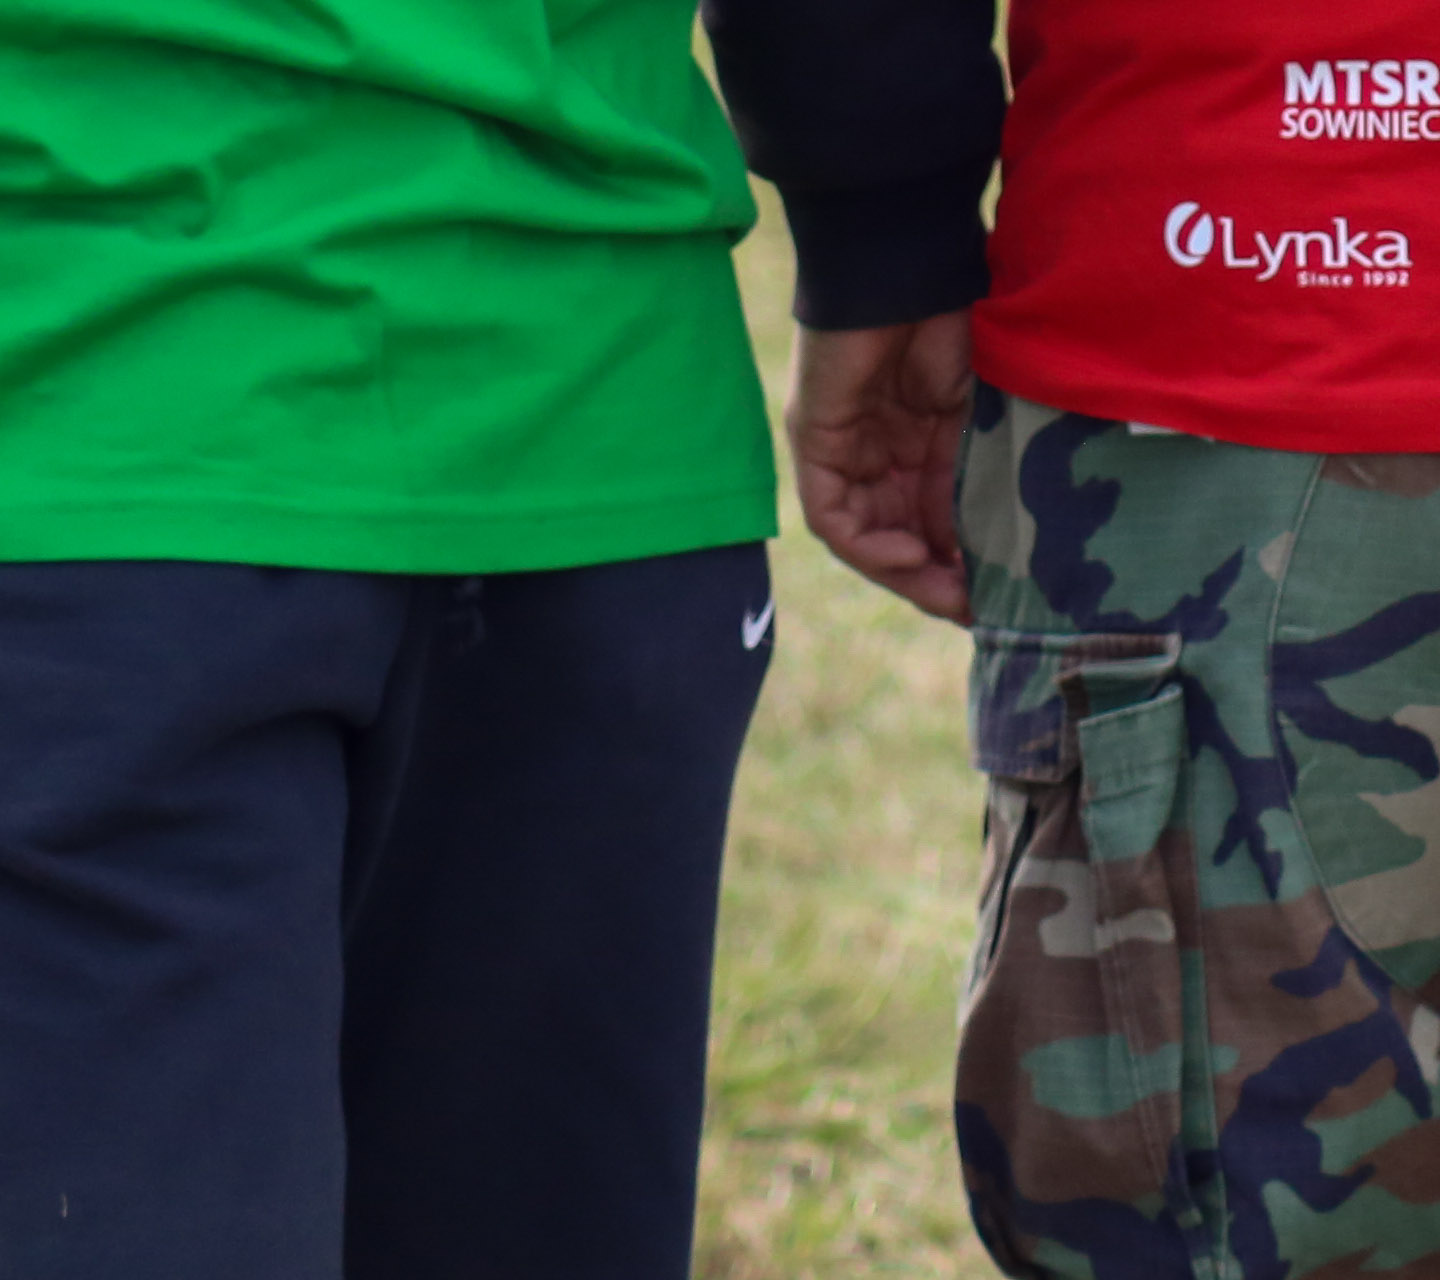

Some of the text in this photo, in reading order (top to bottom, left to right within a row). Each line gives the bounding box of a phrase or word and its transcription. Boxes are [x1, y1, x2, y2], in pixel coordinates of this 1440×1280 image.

[1219, 216, 1413, 282] Lynka
[1297, 270, 1411, 288] Since 1992
